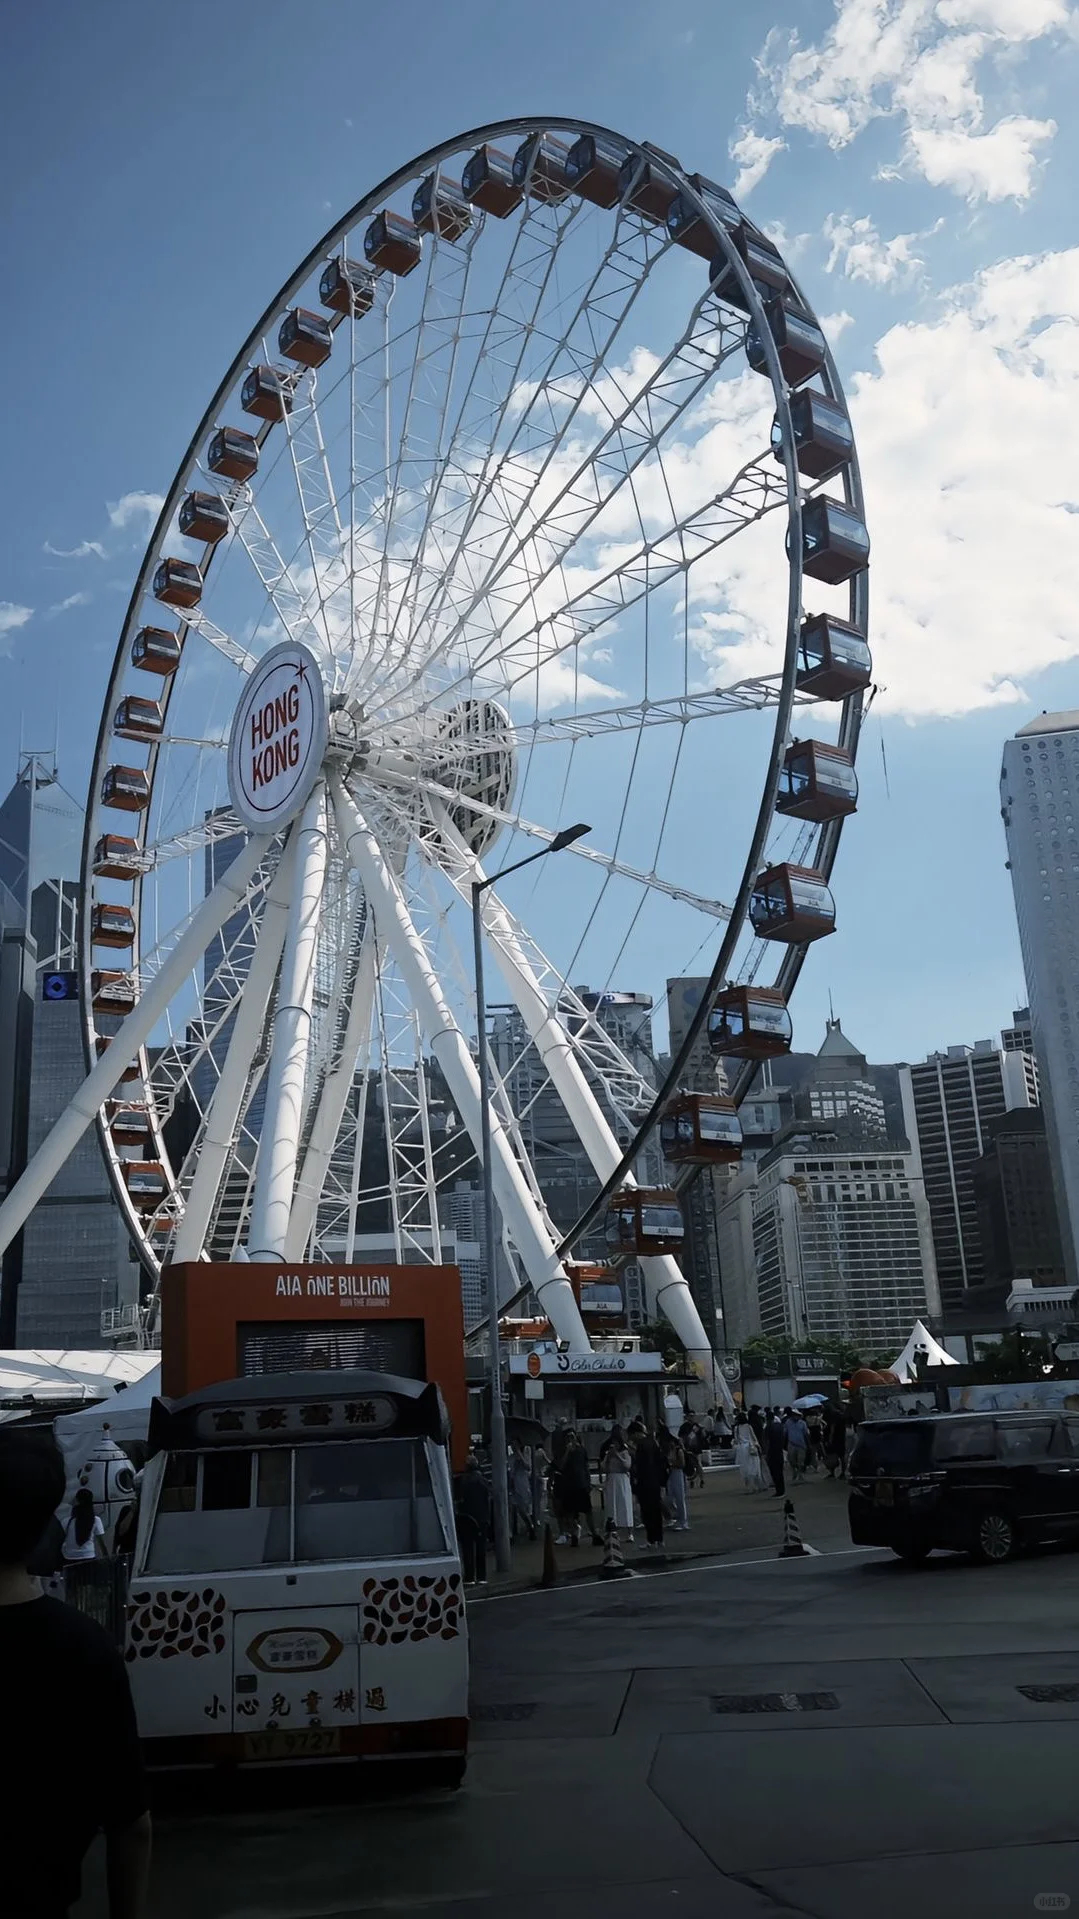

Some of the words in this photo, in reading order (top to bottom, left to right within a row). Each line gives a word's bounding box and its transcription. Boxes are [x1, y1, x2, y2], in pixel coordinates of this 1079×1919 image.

[251, 684, 299, 750] HONG
[252, 729, 299, 792] KONG
[276, 1275, 302, 1296] AIA
[596, 1301, 608, 1309] AIA
[284, 1731, 335, 1754] 9727
